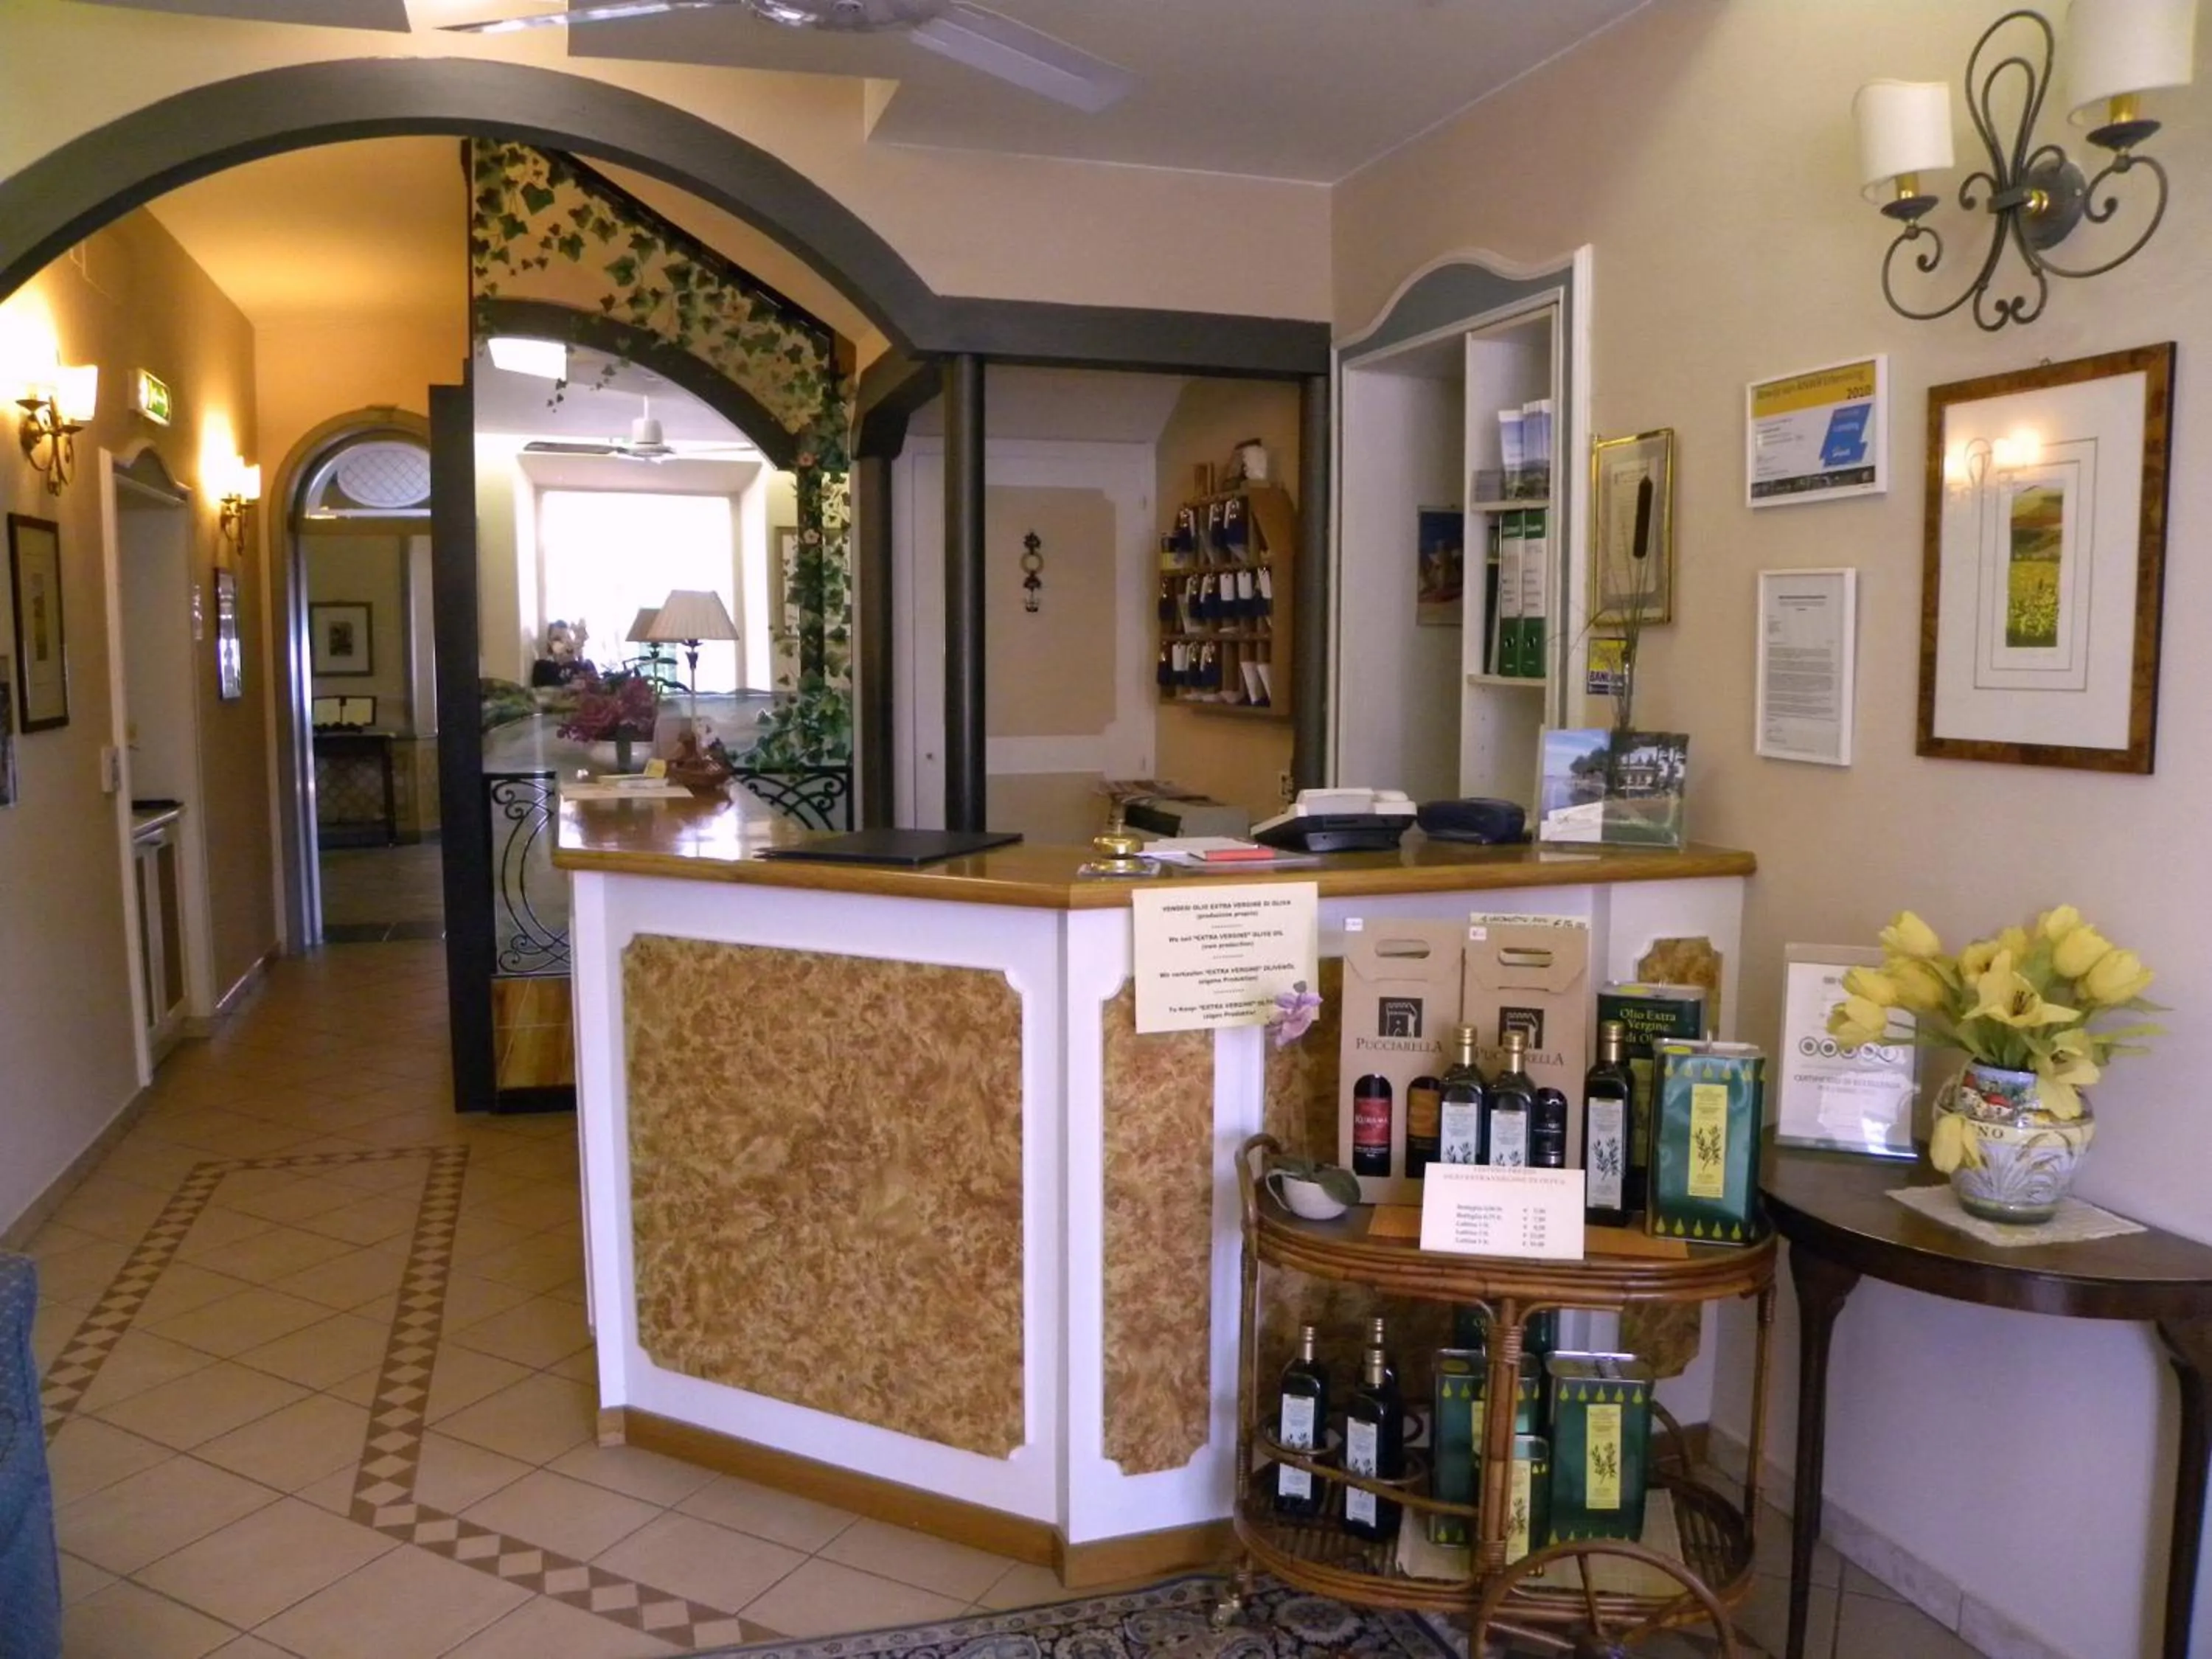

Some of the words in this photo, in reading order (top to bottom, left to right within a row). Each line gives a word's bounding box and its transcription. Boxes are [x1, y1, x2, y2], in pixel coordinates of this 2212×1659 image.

[1620, 1008, 1644, 1019] Olio
[1646, 1009, 1676, 1021] Extra
[1627, 1019, 1669, 1033] Vergine
[1625, 1032, 1636, 1043] di
